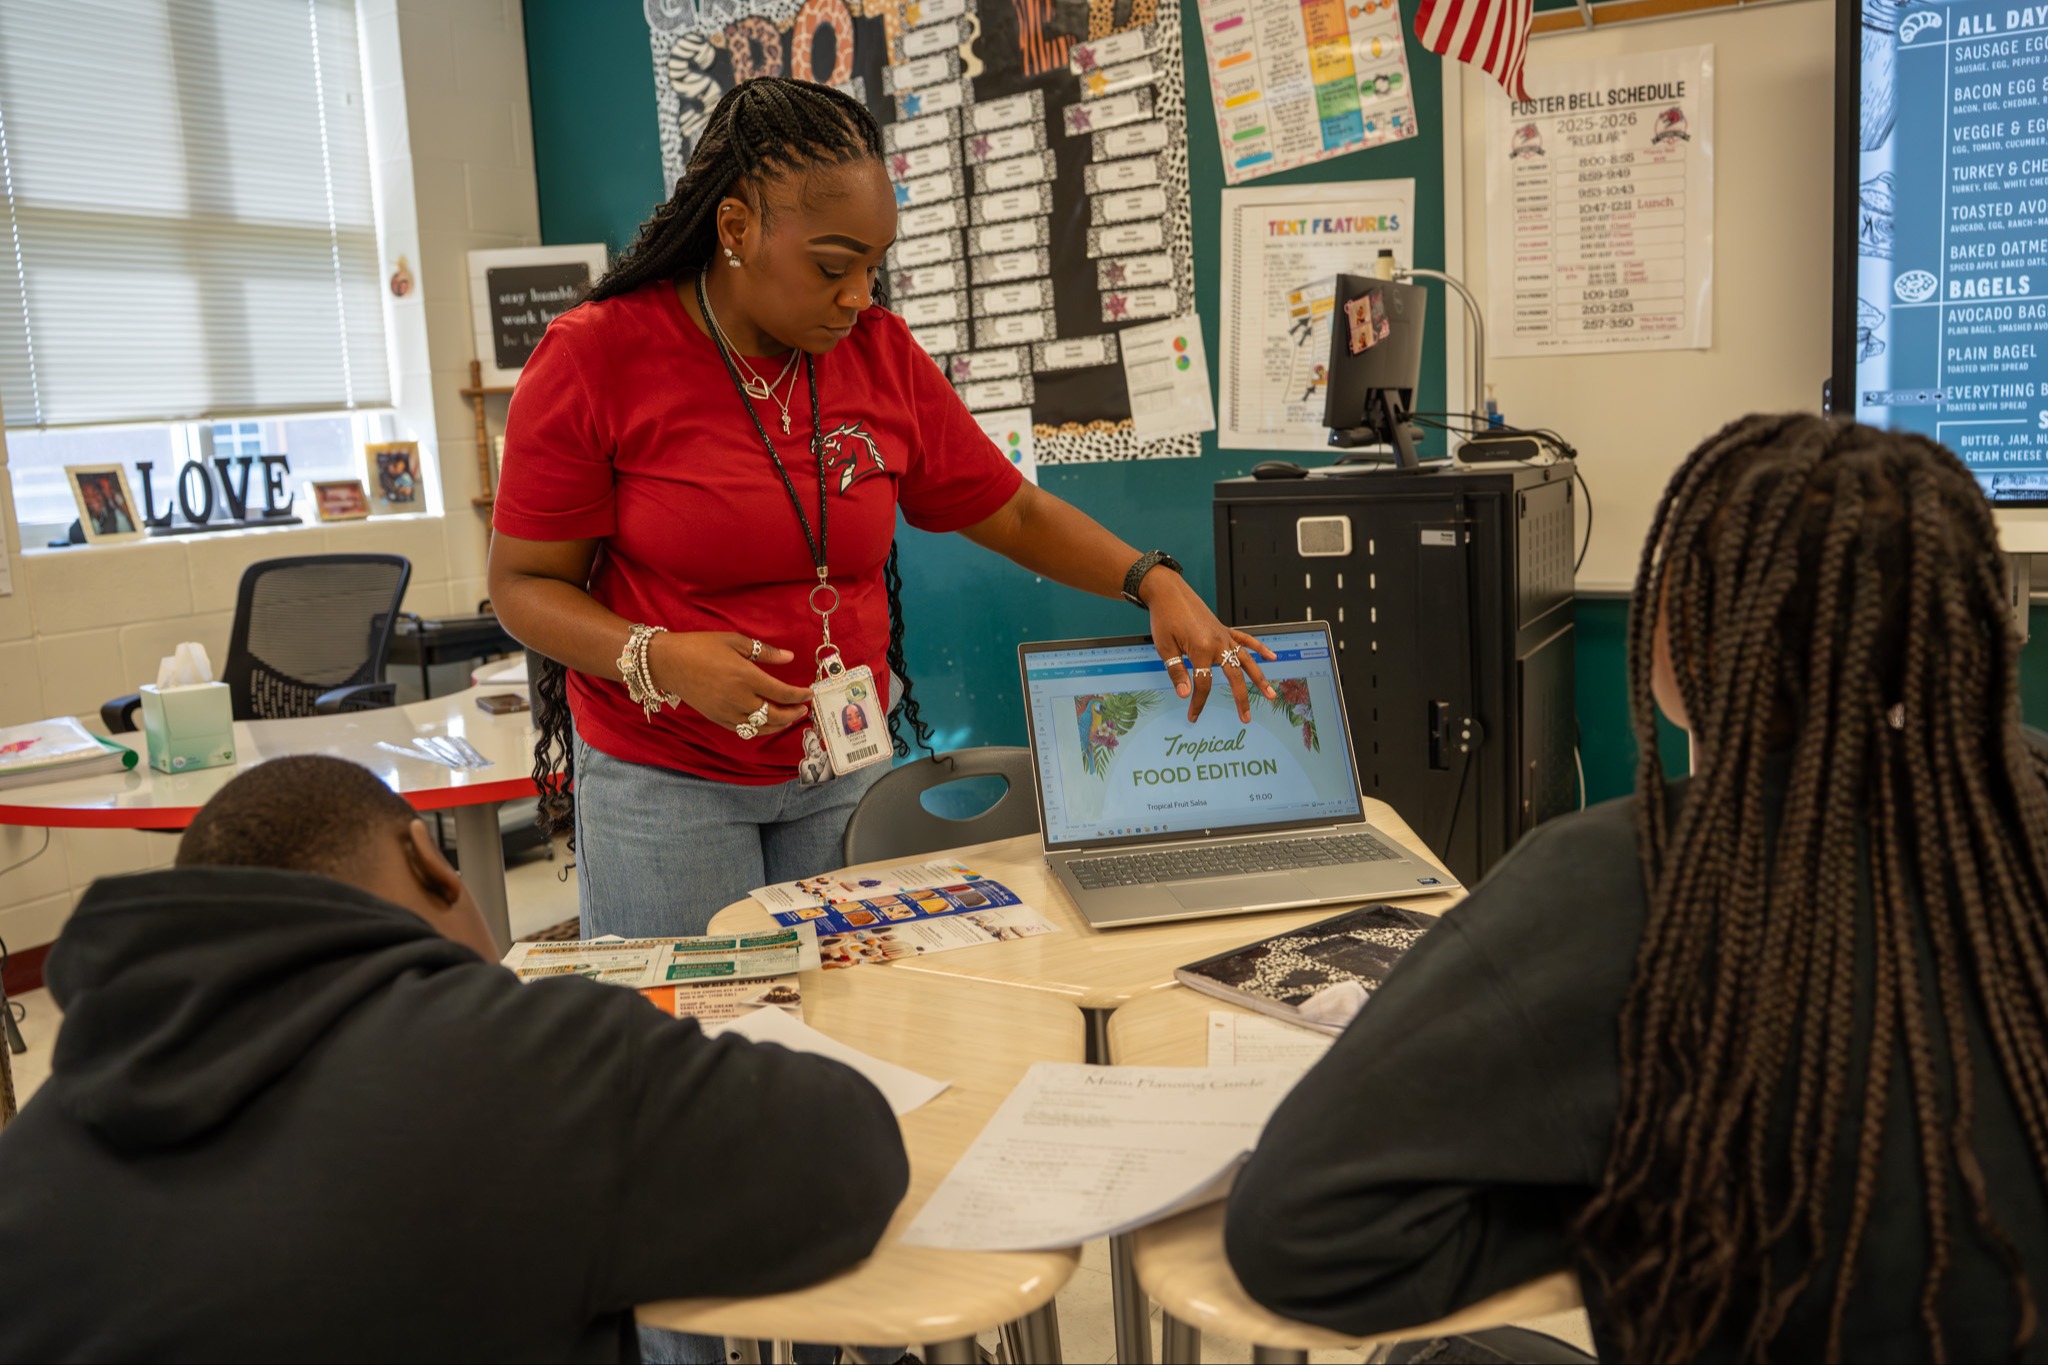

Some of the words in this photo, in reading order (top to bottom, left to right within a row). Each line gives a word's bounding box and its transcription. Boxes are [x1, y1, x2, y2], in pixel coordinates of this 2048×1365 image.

[1958, 14, 1996, 36] ALL
[2006, 5, 2048, 30] DAY
[1956, 40, 2018, 62] SAUSAGE
[1954, 62, 1989, 74] SAUSAGE,
[2012, 56, 2040, 68] PEPPER
[1511, 95, 1565, 117] FOSTER
[1569, 91, 1604, 110] BELL
[1608, 81, 1686, 106] SCHEDULE
[1954, 82, 2002, 102] BACON
[2008, 78, 2036, 95] EGG
[2003, 97, 2040, 108] CHEDDAR,
[1557, 112, 1637, 134] 2025-2026
[1954, 122, 2004, 142] VEGGIE
[2011, 121, 2020, 136] &
[2028, 118, 2048, 134] EG
[1952, 163, 2004, 180] TURKEY
[2008, 162, 2018, 176] &
[2004, 178, 2026, 189] WHITE
[1638, 197, 1674, 209] Lunch
[1952, 202, 2012, 220] TOASTED
[2018, 198, 2046, 214] AVO
[1268, 218, 1307, 236] TEXT
[1312, 215, 1400, 234] FEATURES
[1950, 243, 1996, 260] BAKED
[2002, 239, 2048, 256] OATME
[1950, 262, 1974, 272] SPICED
[1976, 261, 1998, 270] APPLE
[2001, 259, 2025, 268] BAKED
[1950, 275, 2030, 298] BAGELS
[1948, 306, 2012, 323] AVOCADO
[2018, 304, 2048, 320] BAG
[1948, 326, 1968, 335] PLAIN
[1998, 322, 2032, 332] SMASHED
[1948, 346, 1988, 362] PLAIN
[1993, 344, 2037, 360] BAGEL
[1947, 364, 1978, 374] TOASTED
[1980, 363, 1999, 372] WITH
[2001, 362, 2028, 372] SPREAD
[1946, 382, 2034, 400] EVERYTHING
[1946, 402, 1976, 412] TOASTED
[1979, 402, 1998, 410] WITH
[2000, 400, 2028, 410] SPREAD
[1961, 434, 2004, 446] BUTTER,
[2008, 433, 2032, 446] JAM,
[1966, 450, 2000, 462] CREAM
[2004, 450, 2042, 462] CHEESE
[136, 454, 294, 527] LOVE
[1164, 728, 1246, 762] Tropical
[1133, 766, 1191, 786] FOOD
[1197, 758, 1278, 780] EDITION
[1147, 802, 1173, 811] Tropical
[1174, 800, 1189, 808] Fruit
[1190, 799, 1208, 808] Salsa
[1256, 792, 1272, 800] 11.00
[692, 980, 735, 988] SWEET
[739, 978, 777, 986] STUFF
